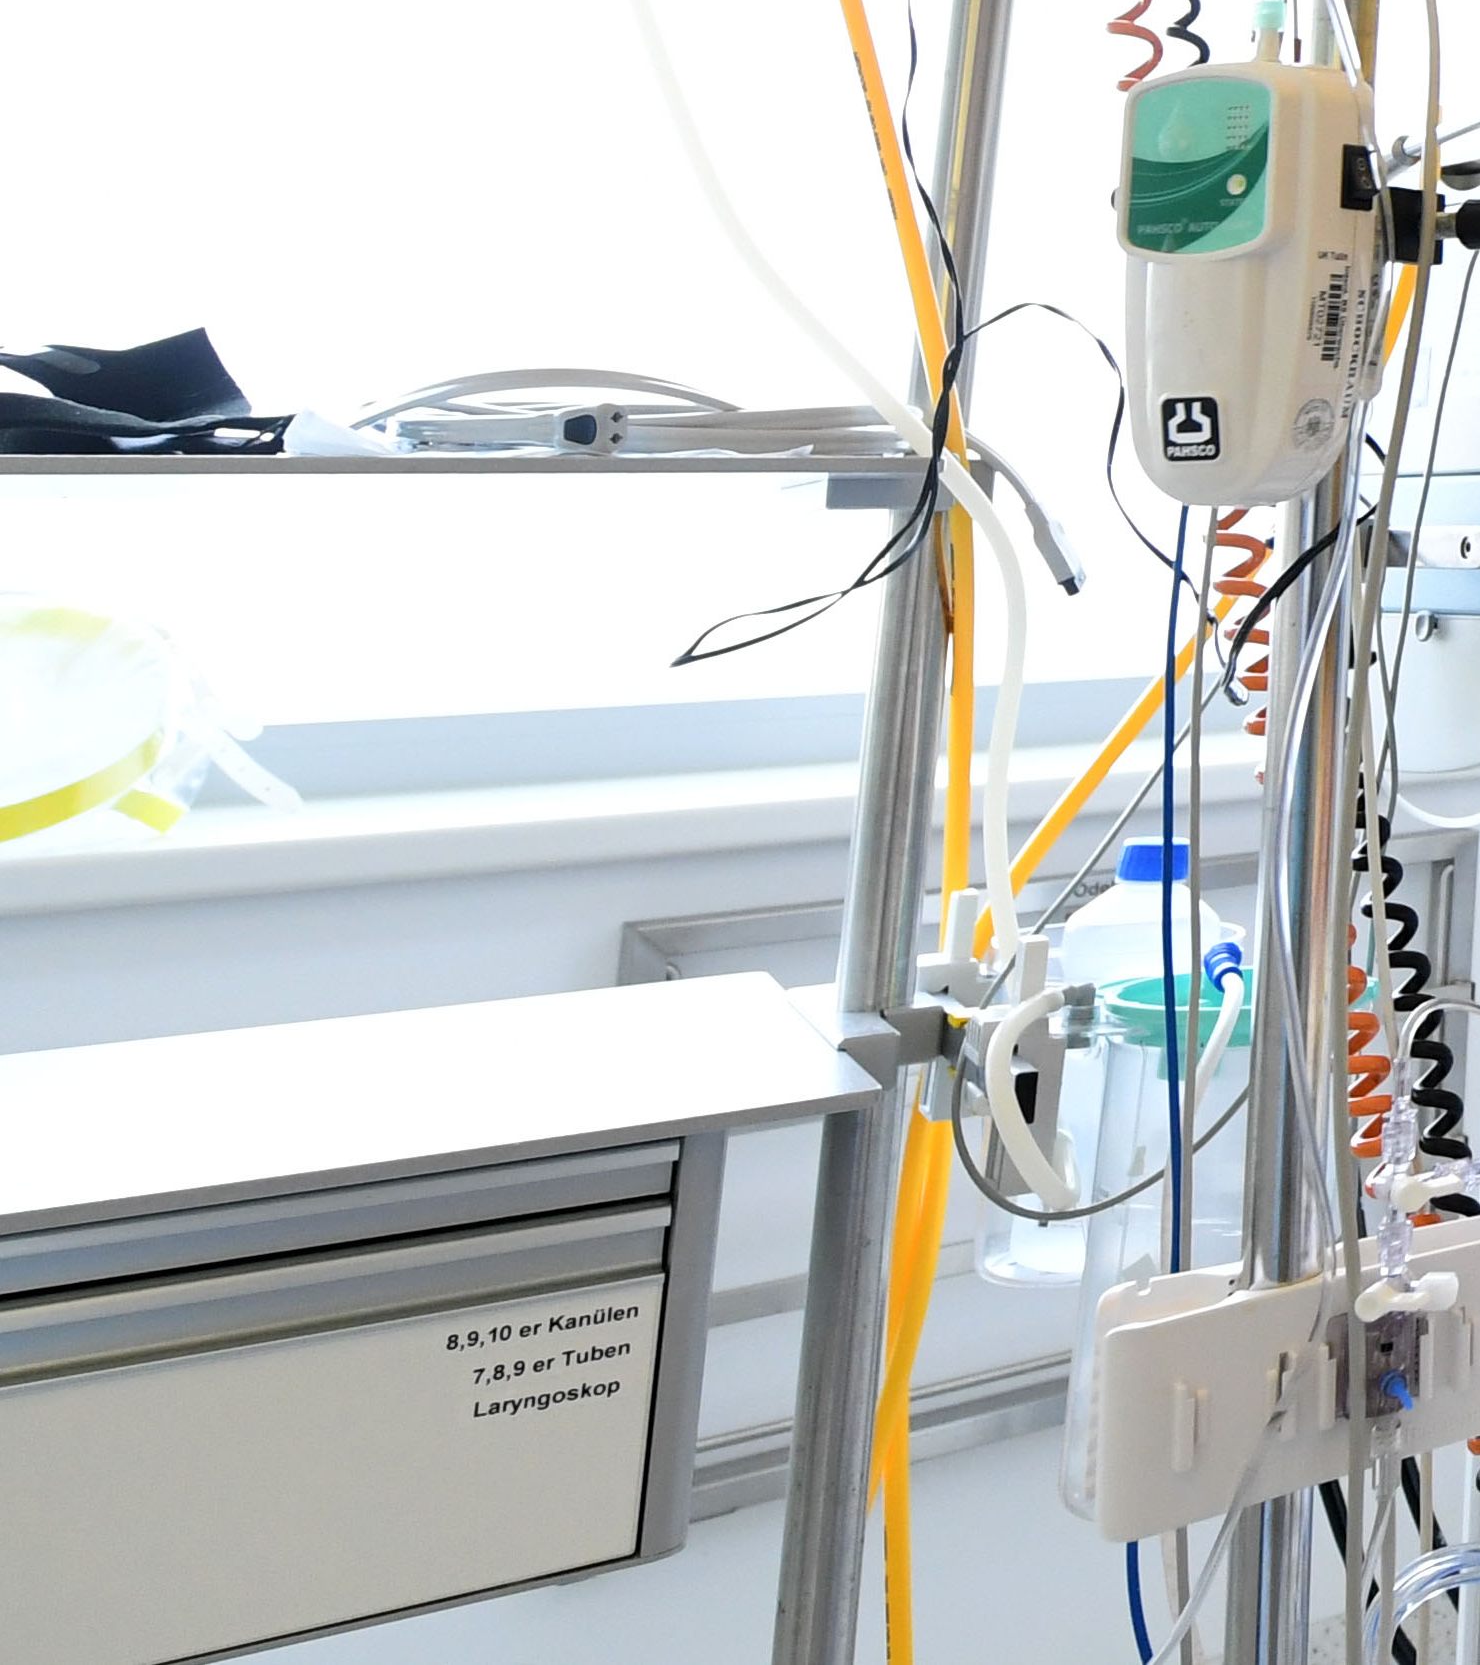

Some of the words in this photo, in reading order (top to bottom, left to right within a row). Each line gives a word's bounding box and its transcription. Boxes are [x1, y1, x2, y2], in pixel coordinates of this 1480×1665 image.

[1166, 444, 1216, 458] PAHSCO
[446, 1324, 513, 1352] 8,9,10
[519, 1322, 542, 1338] er
[548, 1305, 640, 1333] Kanülen
[473, 1360, 526, 1386] 7,8,9
[532, 1357, 555, 1373] er
[562, 1342, 631, 1367] Tuben
[473, 1380, 621, 1418] Laryngoskop
